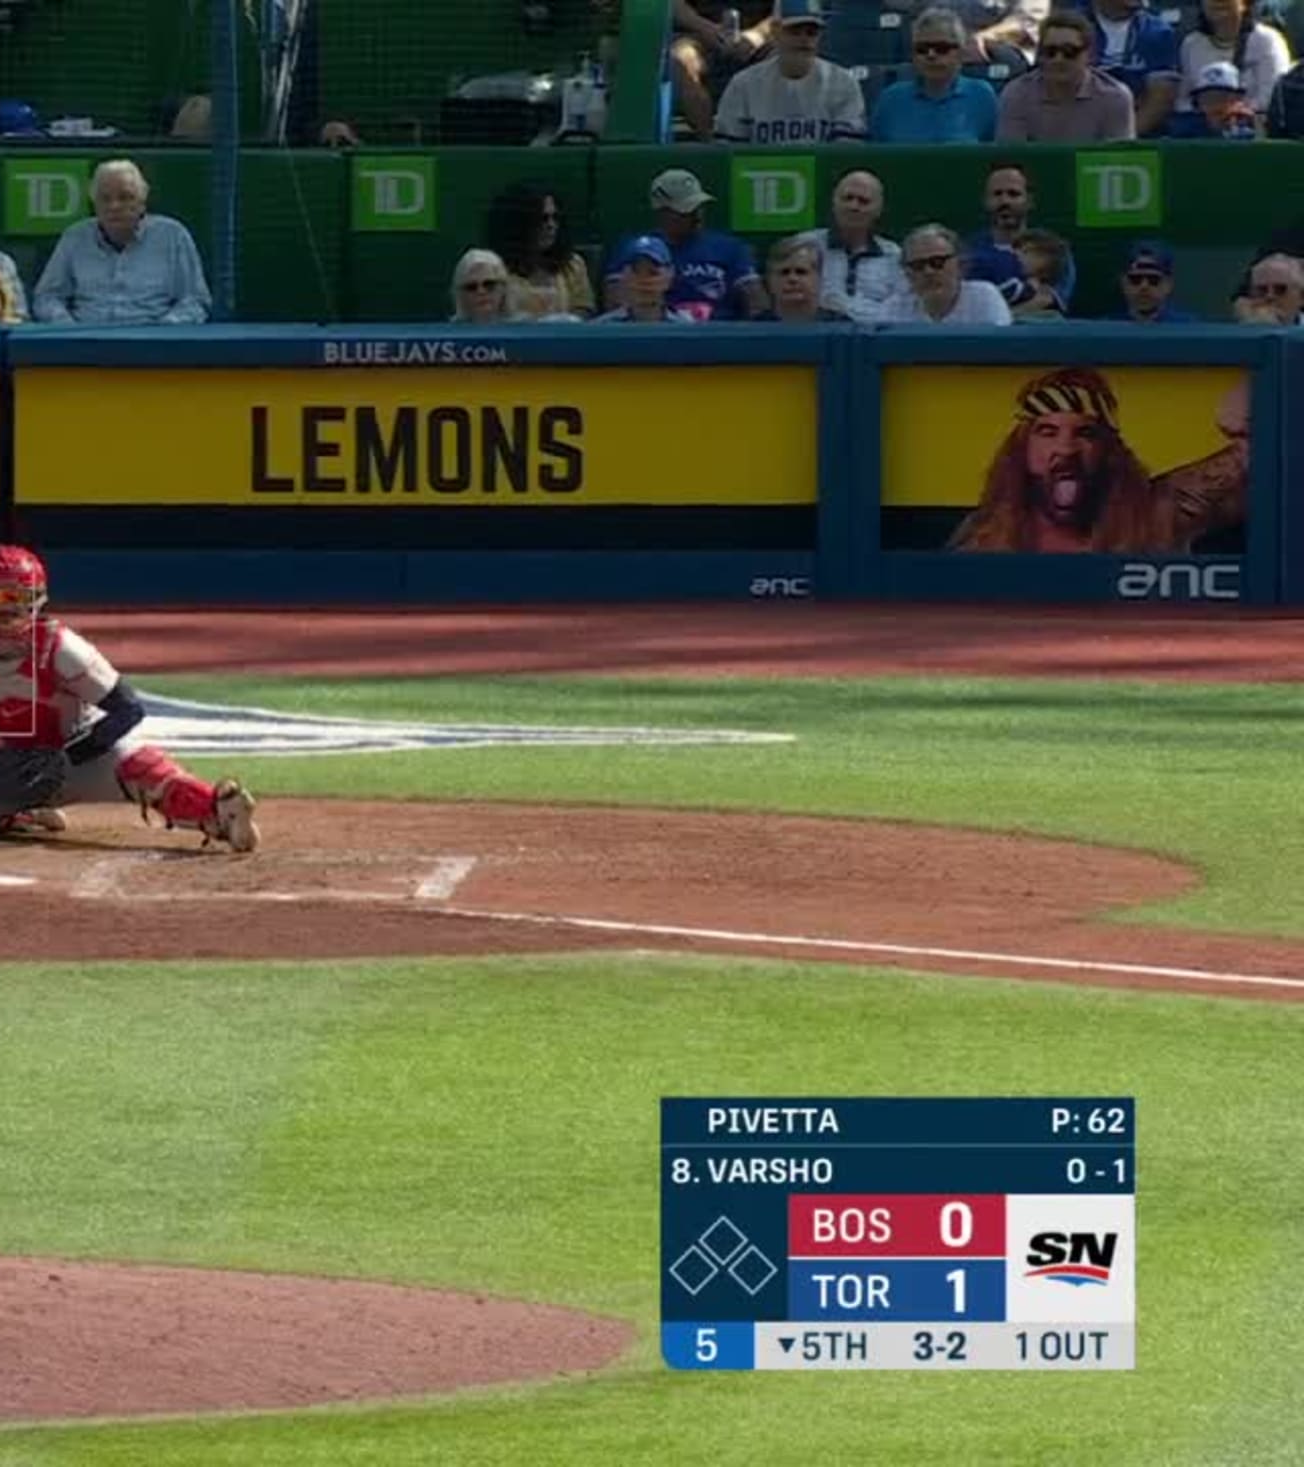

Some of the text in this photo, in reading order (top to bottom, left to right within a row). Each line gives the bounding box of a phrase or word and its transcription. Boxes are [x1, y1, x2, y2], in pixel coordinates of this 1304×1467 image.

[13, 172, 80, 218] TD
[360, 170, 425, 216] TD
[742, 169, 806, 215] TD
[1083, 165, 1151, 211] TD
[323, 341, 507, 364] BLUEJAYS.COM
[251, 406, 584, 493] LEMONS
